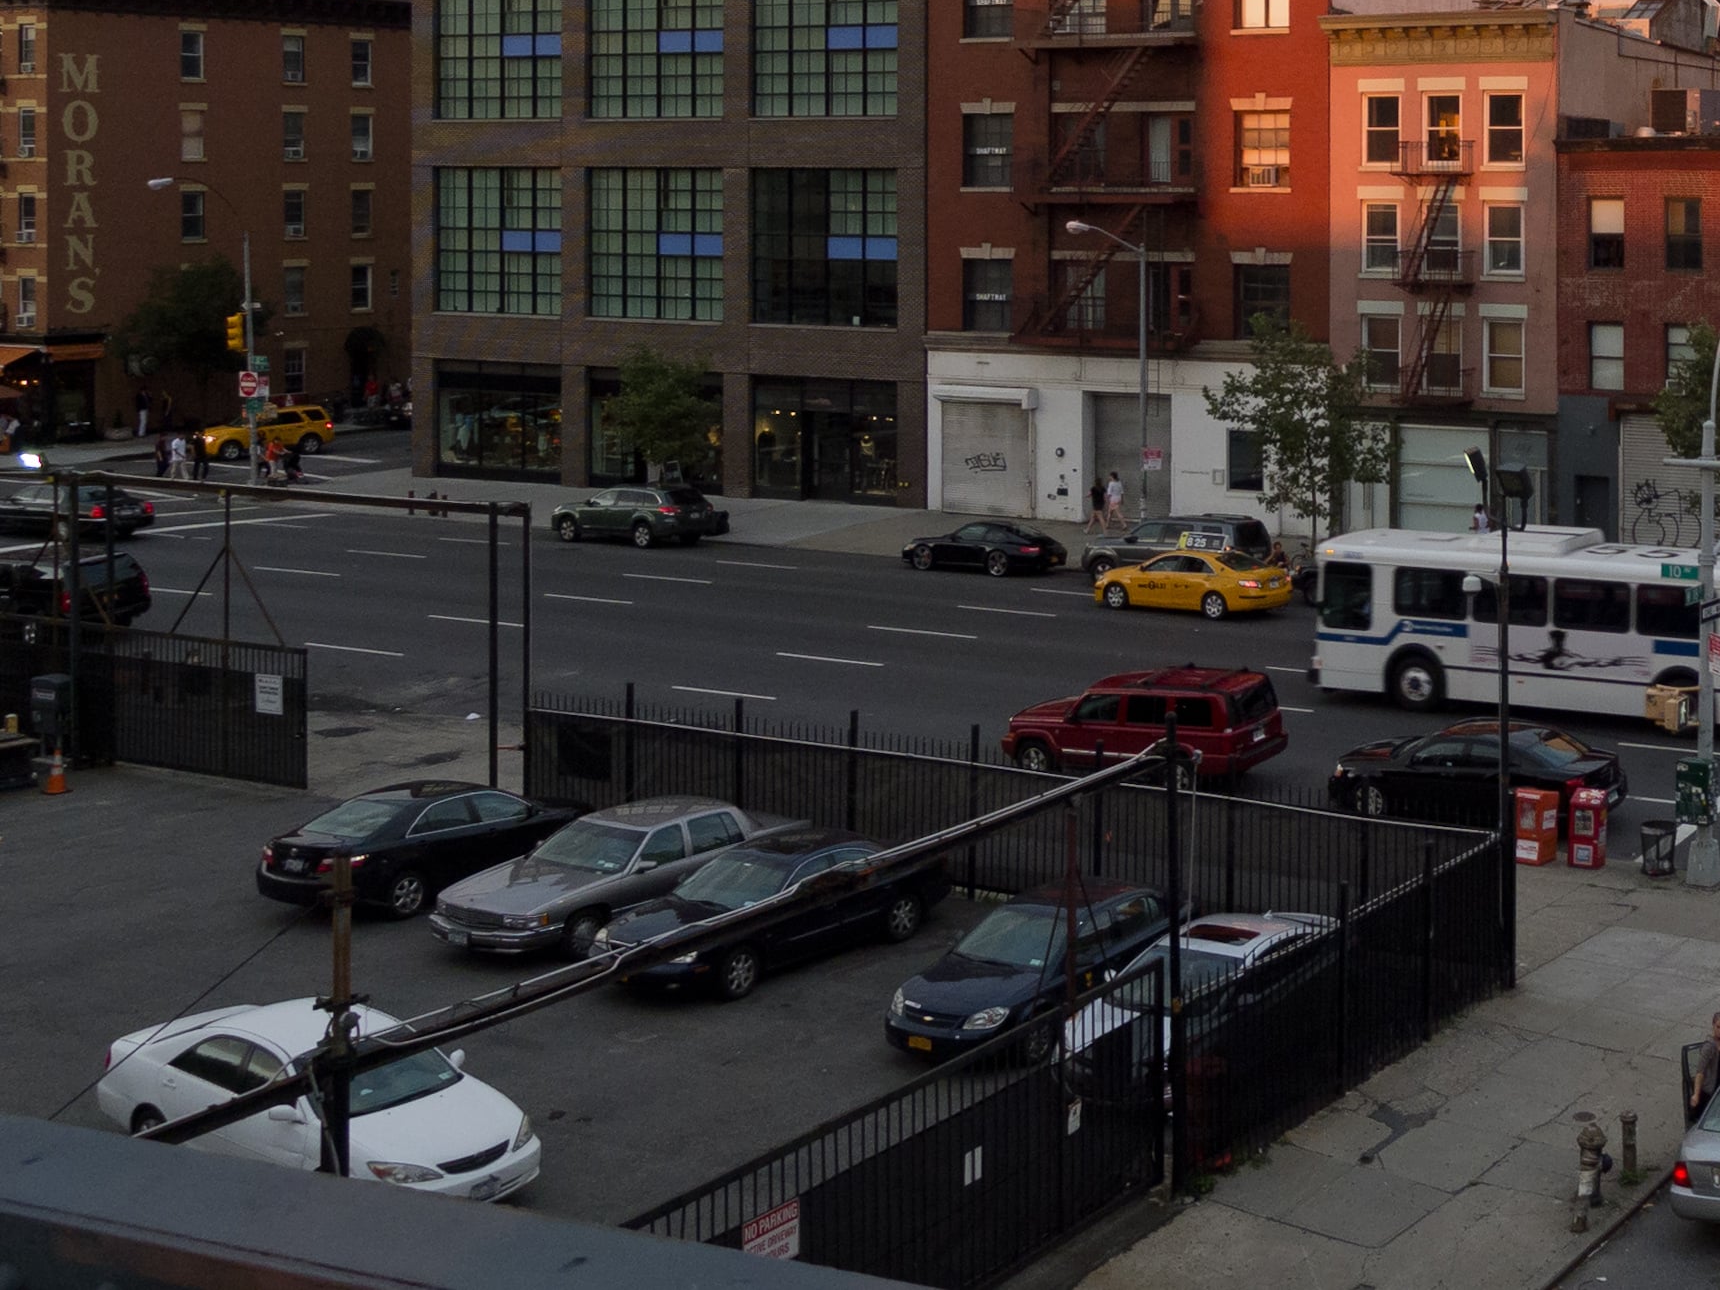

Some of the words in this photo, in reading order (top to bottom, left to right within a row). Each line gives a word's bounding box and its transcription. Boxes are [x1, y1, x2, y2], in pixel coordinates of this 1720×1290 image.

[1668, 565, 1682, 578] 10
[744, 1222, 758, 1242] NO
[759, 1202, 798, 1235] PARKING
